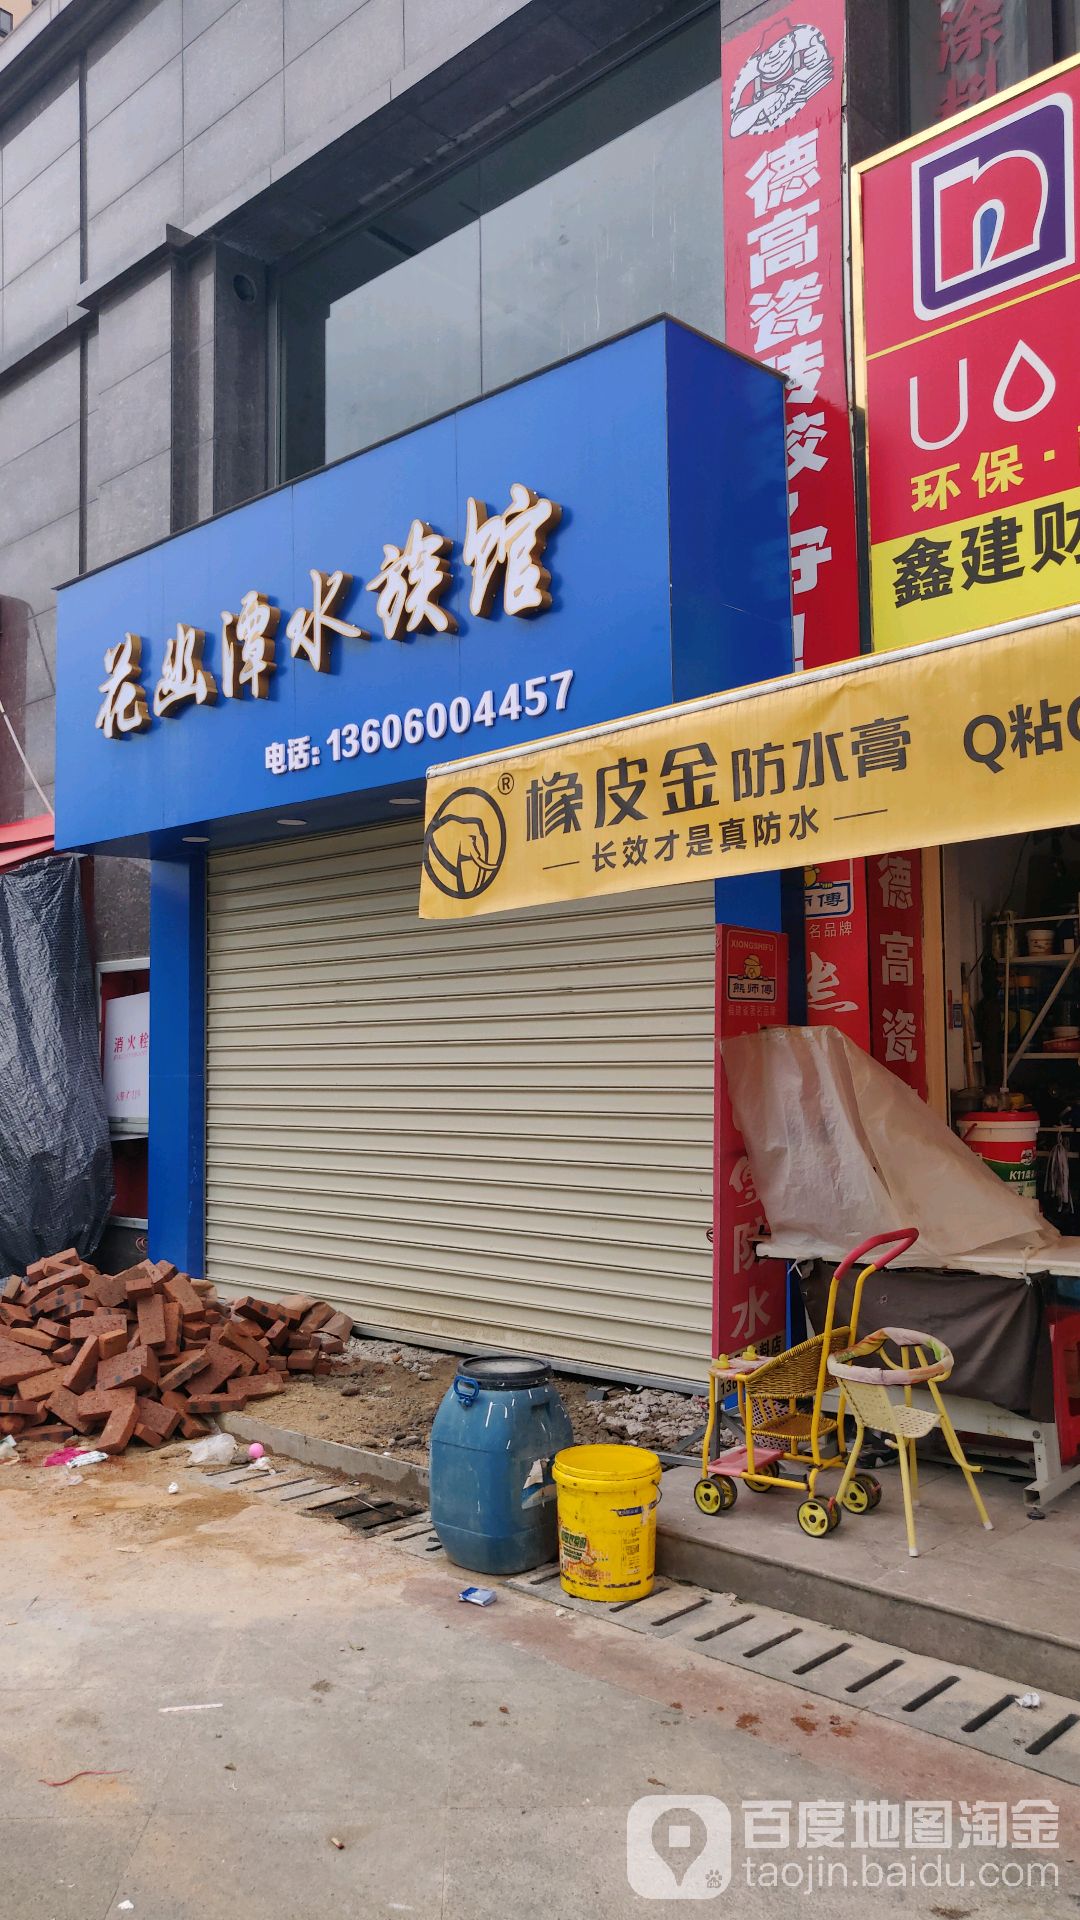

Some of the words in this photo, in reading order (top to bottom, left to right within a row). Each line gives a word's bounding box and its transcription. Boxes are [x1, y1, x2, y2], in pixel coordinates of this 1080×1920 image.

[525, 715, 911, 842] 橡皮金防水膏
[808, 921, 852, 938] 名品牌
[114, 1032, 149, 1053] 消火栓
